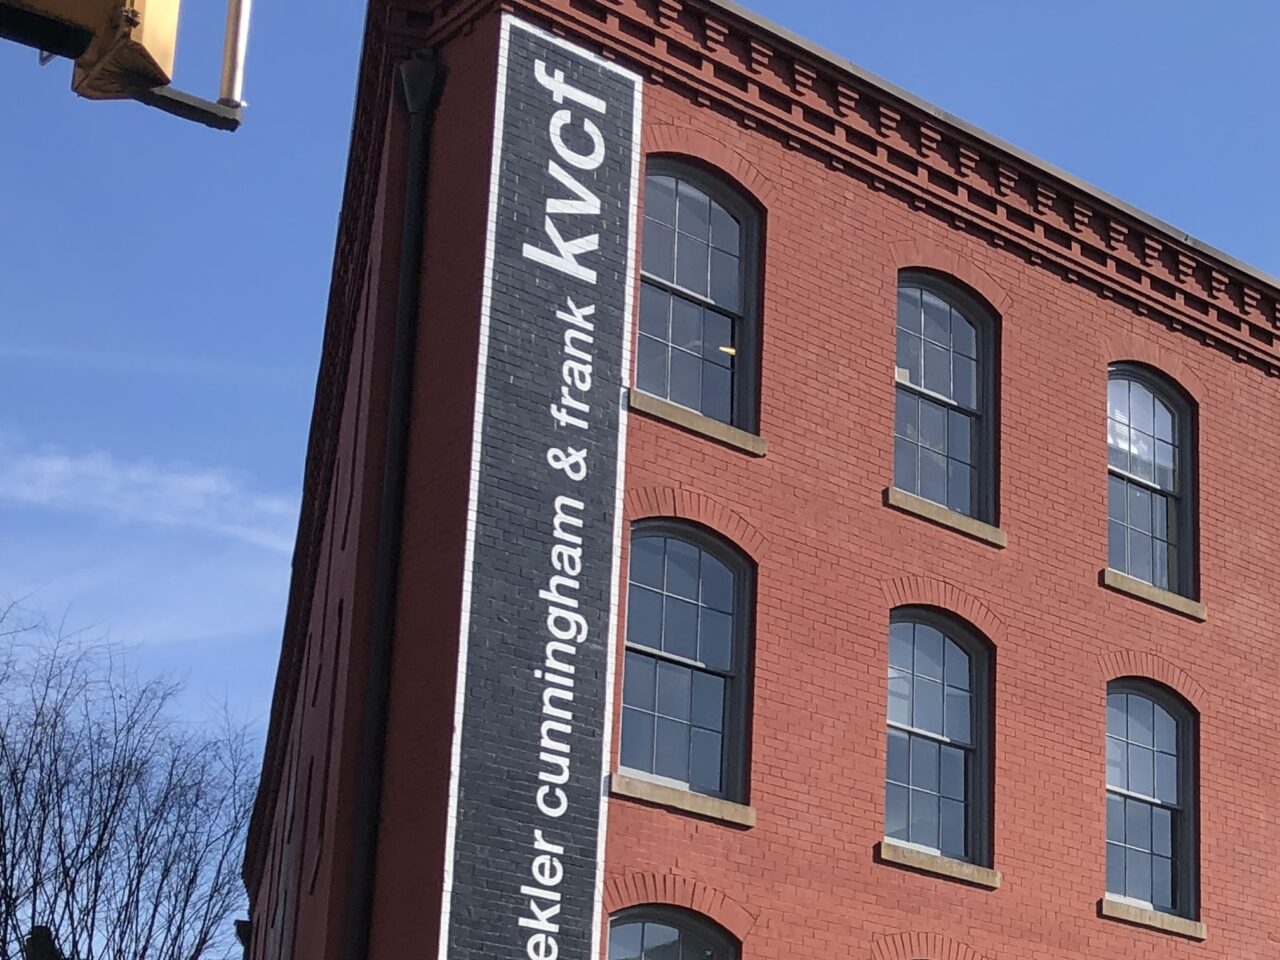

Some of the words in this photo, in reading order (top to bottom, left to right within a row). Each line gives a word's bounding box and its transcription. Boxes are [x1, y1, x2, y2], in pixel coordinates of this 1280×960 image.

[522, 58, 607, 285] kvcf
[551, 296, 596, 430] frank
[546, 447, 588, 482] &
[534, 495, 589, 818] cunningham
